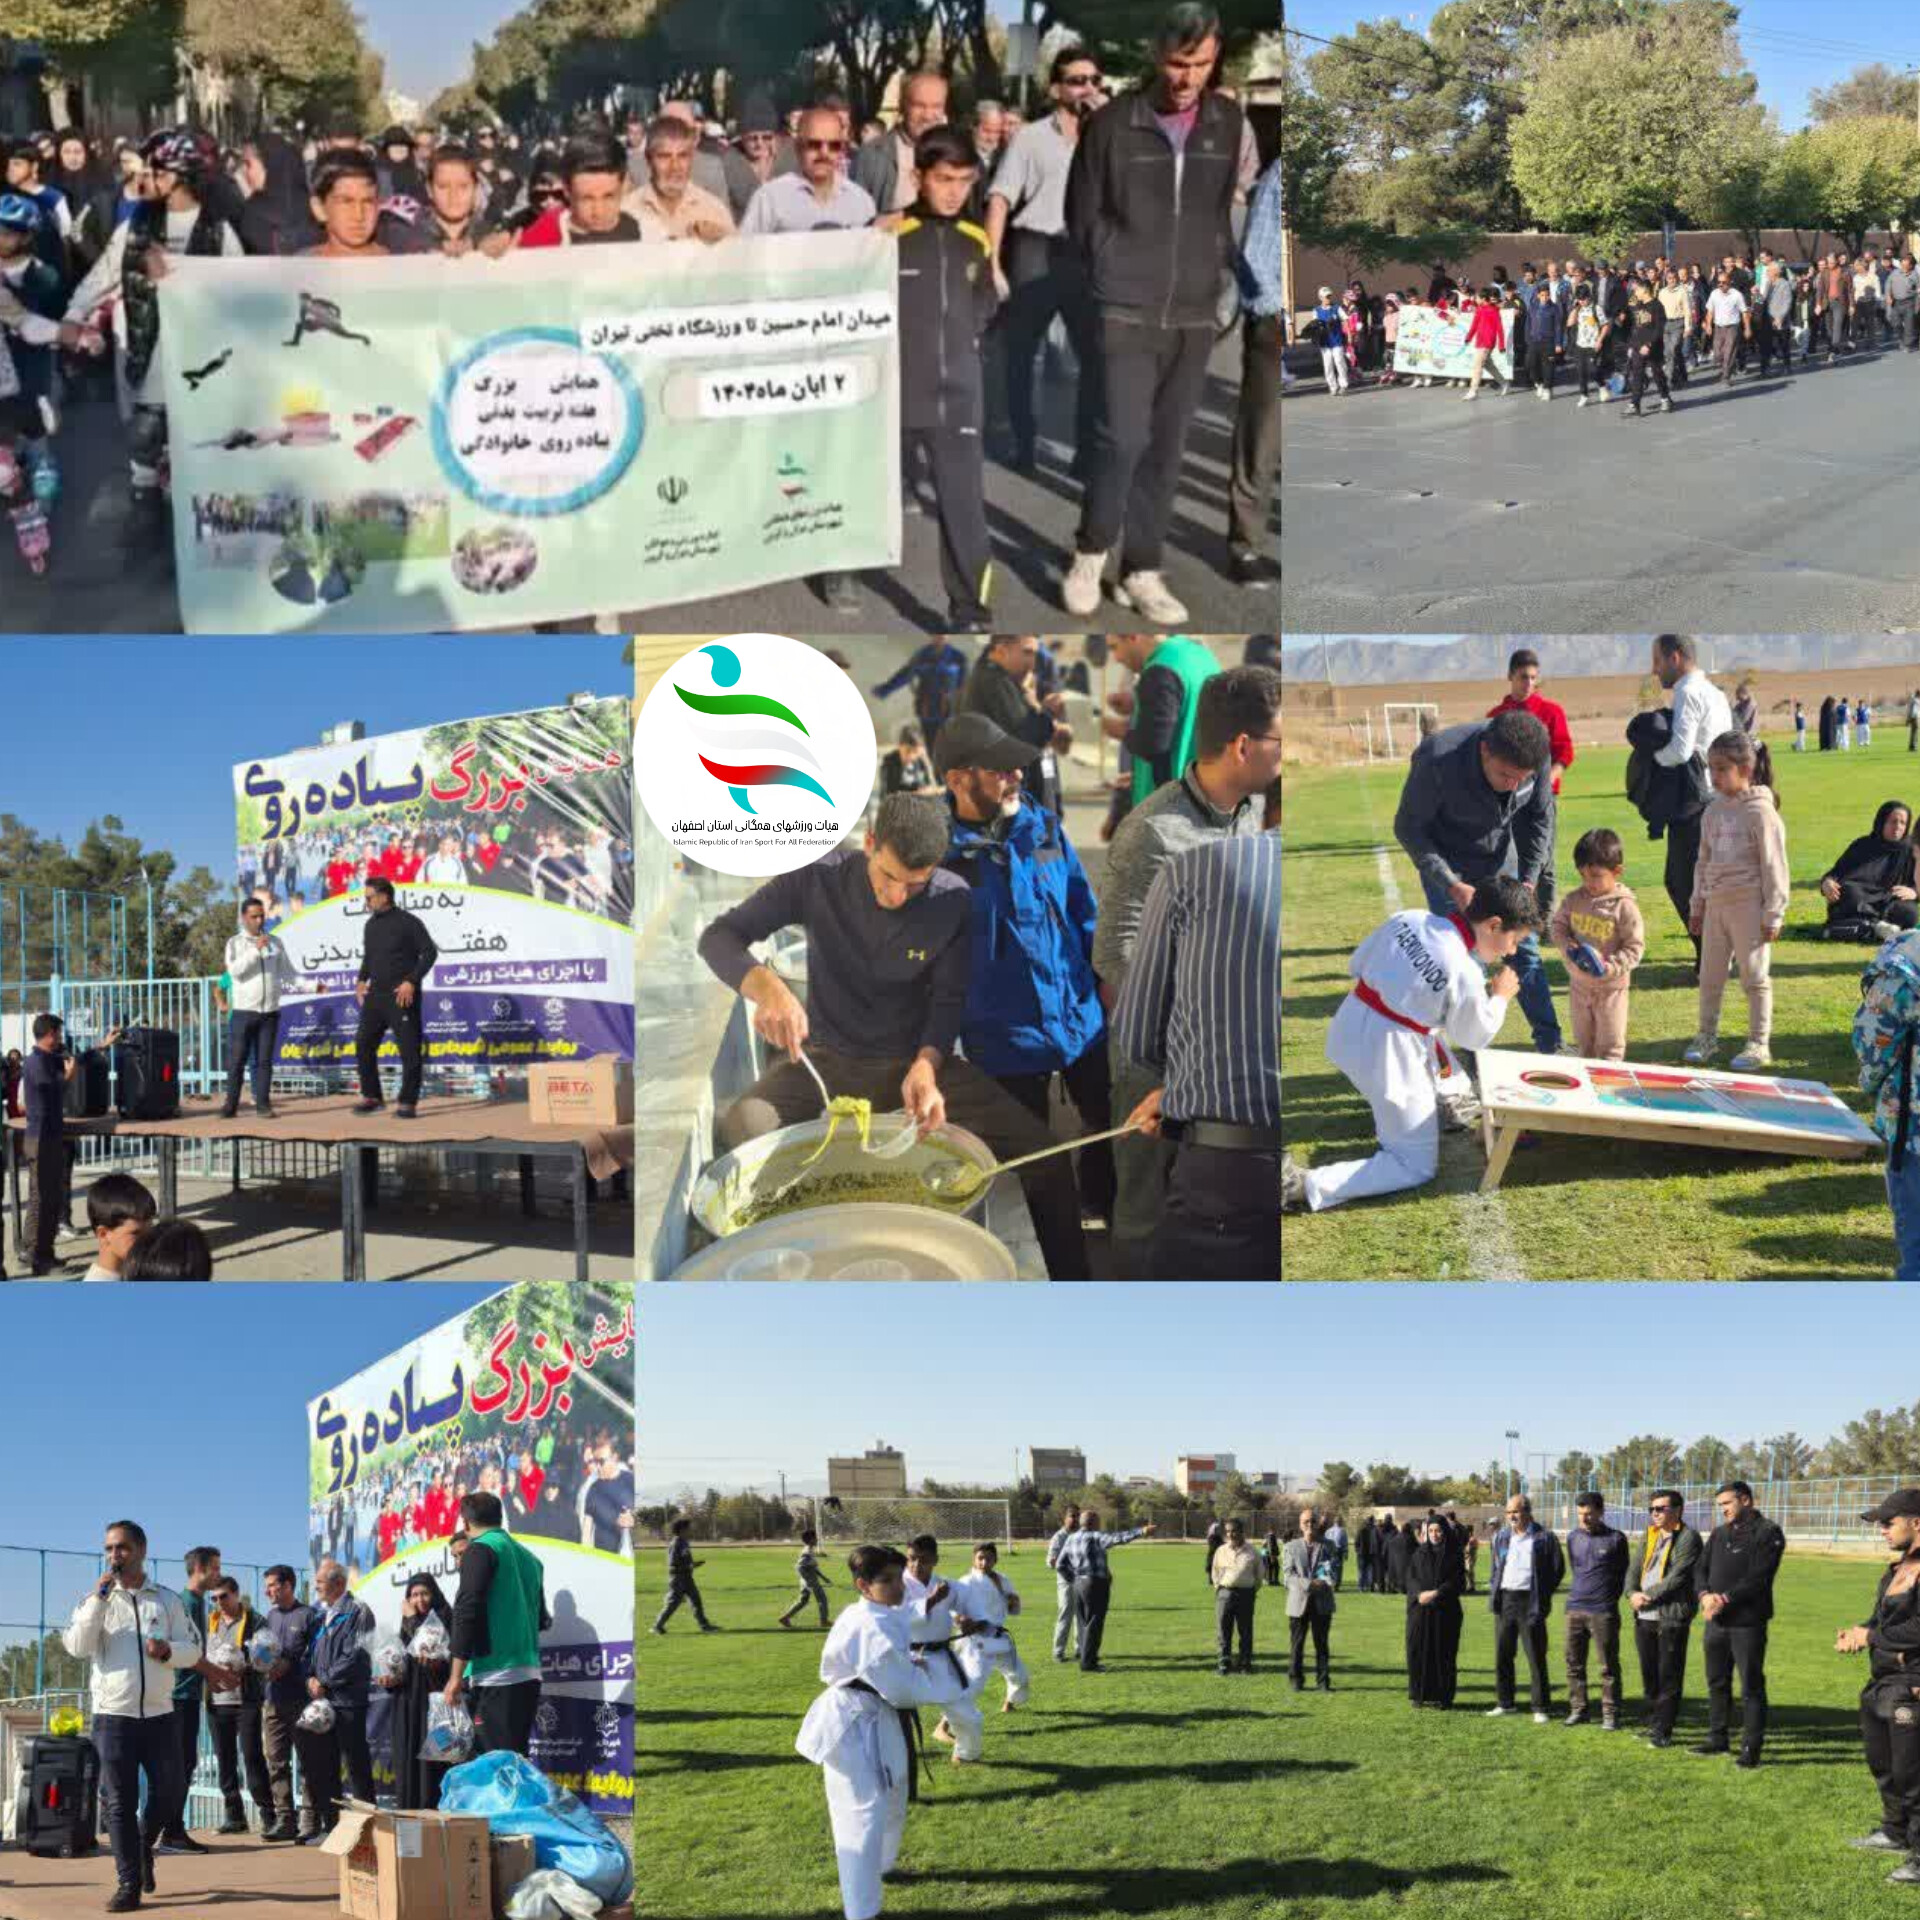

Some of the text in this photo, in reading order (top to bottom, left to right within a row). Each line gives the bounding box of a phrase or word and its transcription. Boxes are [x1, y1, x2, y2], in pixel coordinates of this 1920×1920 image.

[746, 317, 757, 332] تا
[762, 317, 809, 336] حسین
[811, 311, 844, 334] امام
[846, 308, 892, 331] میدان
[591, 325, 630, 346] تیران
[635, 326, 674, 345] تختی
[474, 373, 600, 397] همایش بزرگ
[834, 374, 846, 391] ۲
[478, 403, 597, 424] هفته تربیت بدنی
[460, 433, 532, 455] خانوادگی
[540, 436, 573, 454] روی
[430, 741, 526, 813] بزرگ
[438, 890, 465, 916] به
[302, 943, 353, 970] بدنی
[1395, 923, 1448, 992] TAEKWONDO
[443, 962, 595, 985] با اجرای هیات ورزشی
[469, 1317, 576, 1424] بزرگ
[585, 1649, 634, 1676] جرای
